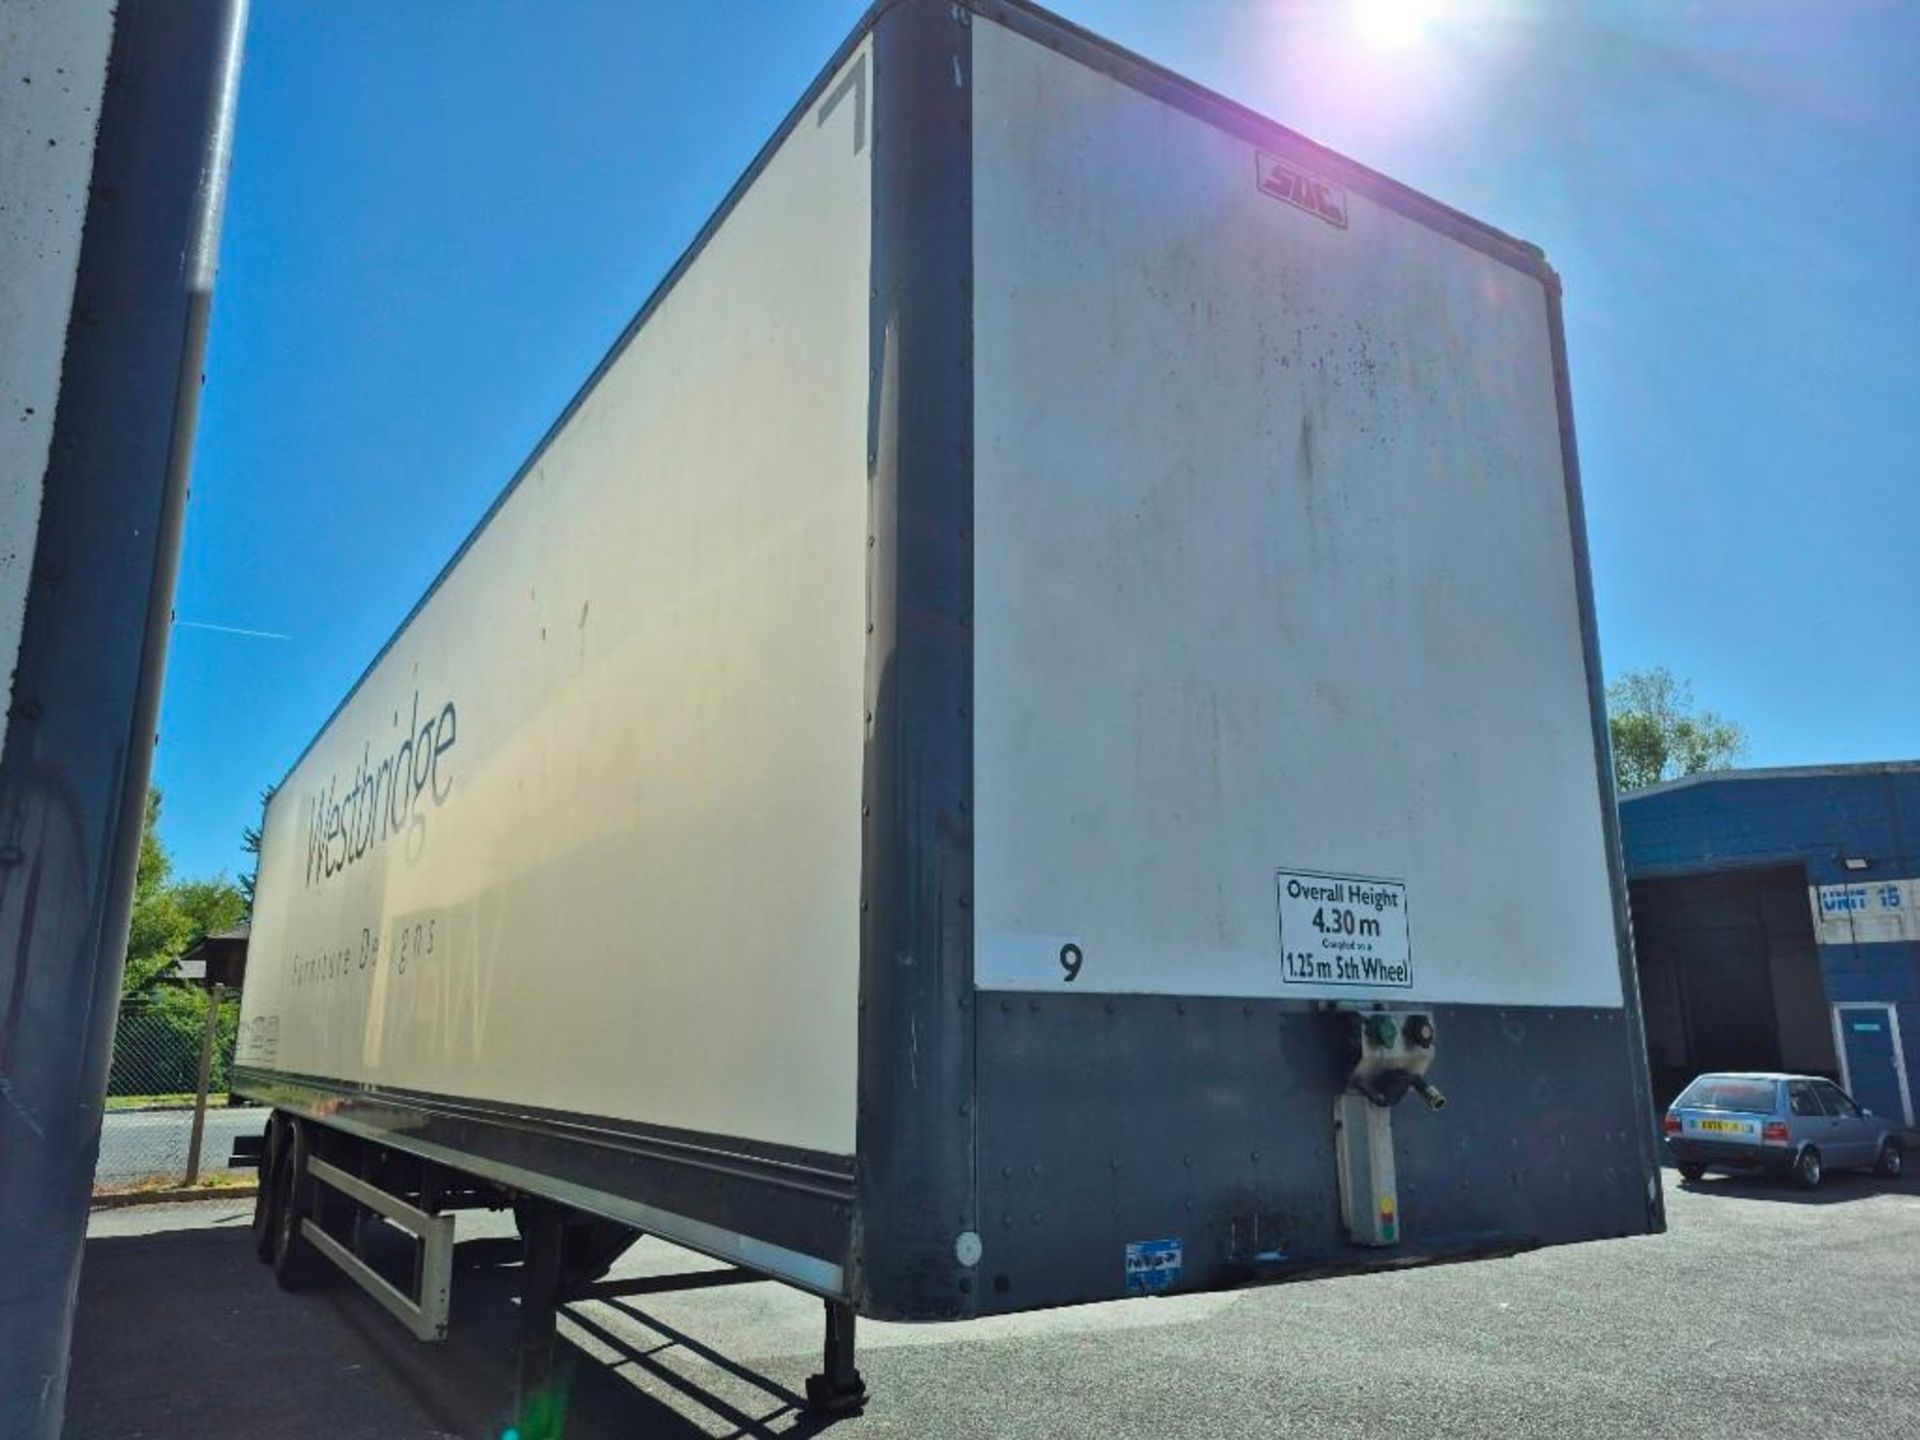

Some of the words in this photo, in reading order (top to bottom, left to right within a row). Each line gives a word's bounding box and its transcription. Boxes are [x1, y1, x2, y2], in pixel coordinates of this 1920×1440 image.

[306, 668, 457, 887] Westbridge
[1287, 879, 1344, 902] Overall
[1348, 884, 1399, 912] Height
[1822, 890, 1867, 911] UNIT
[1312, 907, 1356, 936] 4.30
[1359, 918, 1380, 937] m
[359, 918, 436, 975] Deigns
[1060, 943, 1083, 982] 9
[1286, 952, 1315, 978] 1.25
[1316, 961, 1332, 979] m
[1336, 955, 1360, 980] 5th
[1361, 957, 1409, 983] Wheel
